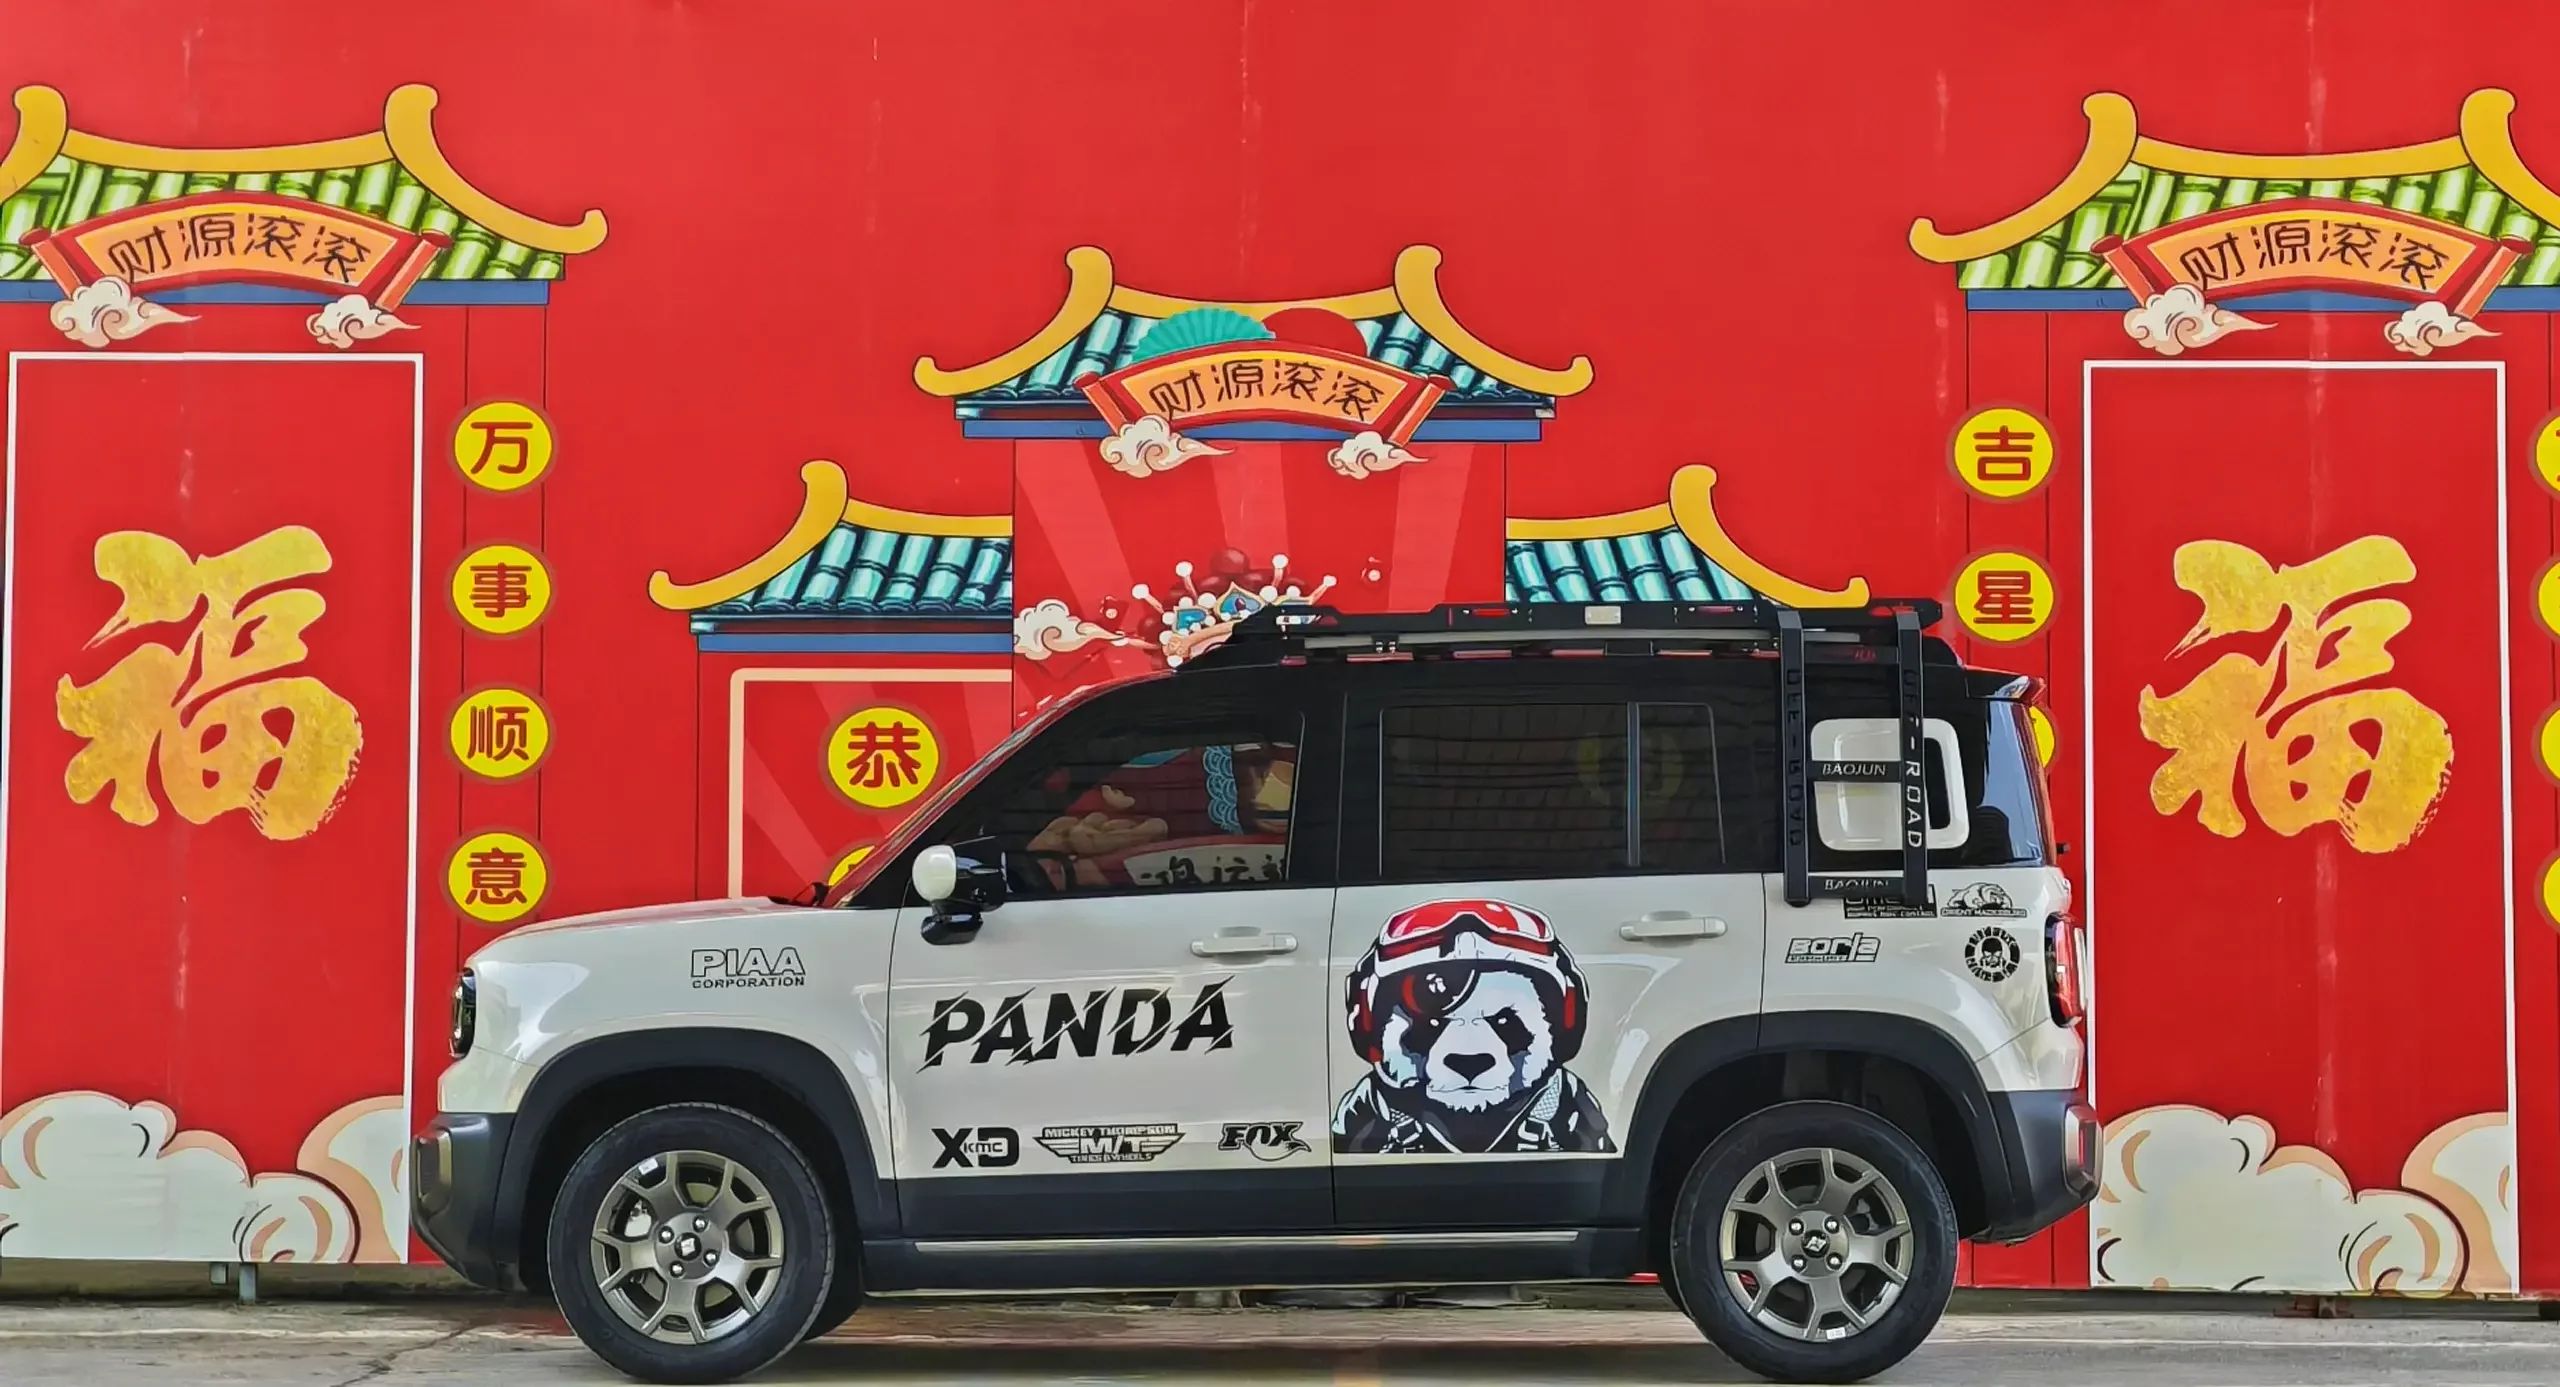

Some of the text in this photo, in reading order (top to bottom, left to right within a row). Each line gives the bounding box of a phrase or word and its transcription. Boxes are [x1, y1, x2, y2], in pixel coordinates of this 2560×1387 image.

[108, 212, 371, 286] 财源滚滚
[2179, 218, 2450, 290] 财源滚滚
[1150, 358, 1385, 422] 财源滚滚
[56, 525, 363, 841] 福
[465, 420, 534, 905] 万事顺意
[2138, 534, 2455, 854] 福
[846, 721, 922, 788] 恭
[1822, 763, 1886, 776] BAOJUN
[691, 946, 806, 978] PIAA
[692, 976, 805, 989] CORPORATION
[916, 975, 1236, 1074] PANDA
[931, 1126, 1020, 1169] XD
[1044, 1124, 1177, 1138] MICKEY THOMPSON
[1080, 1135, 1142, 1154] M/T
[1218, 1121, 1307, 1154] FOX
